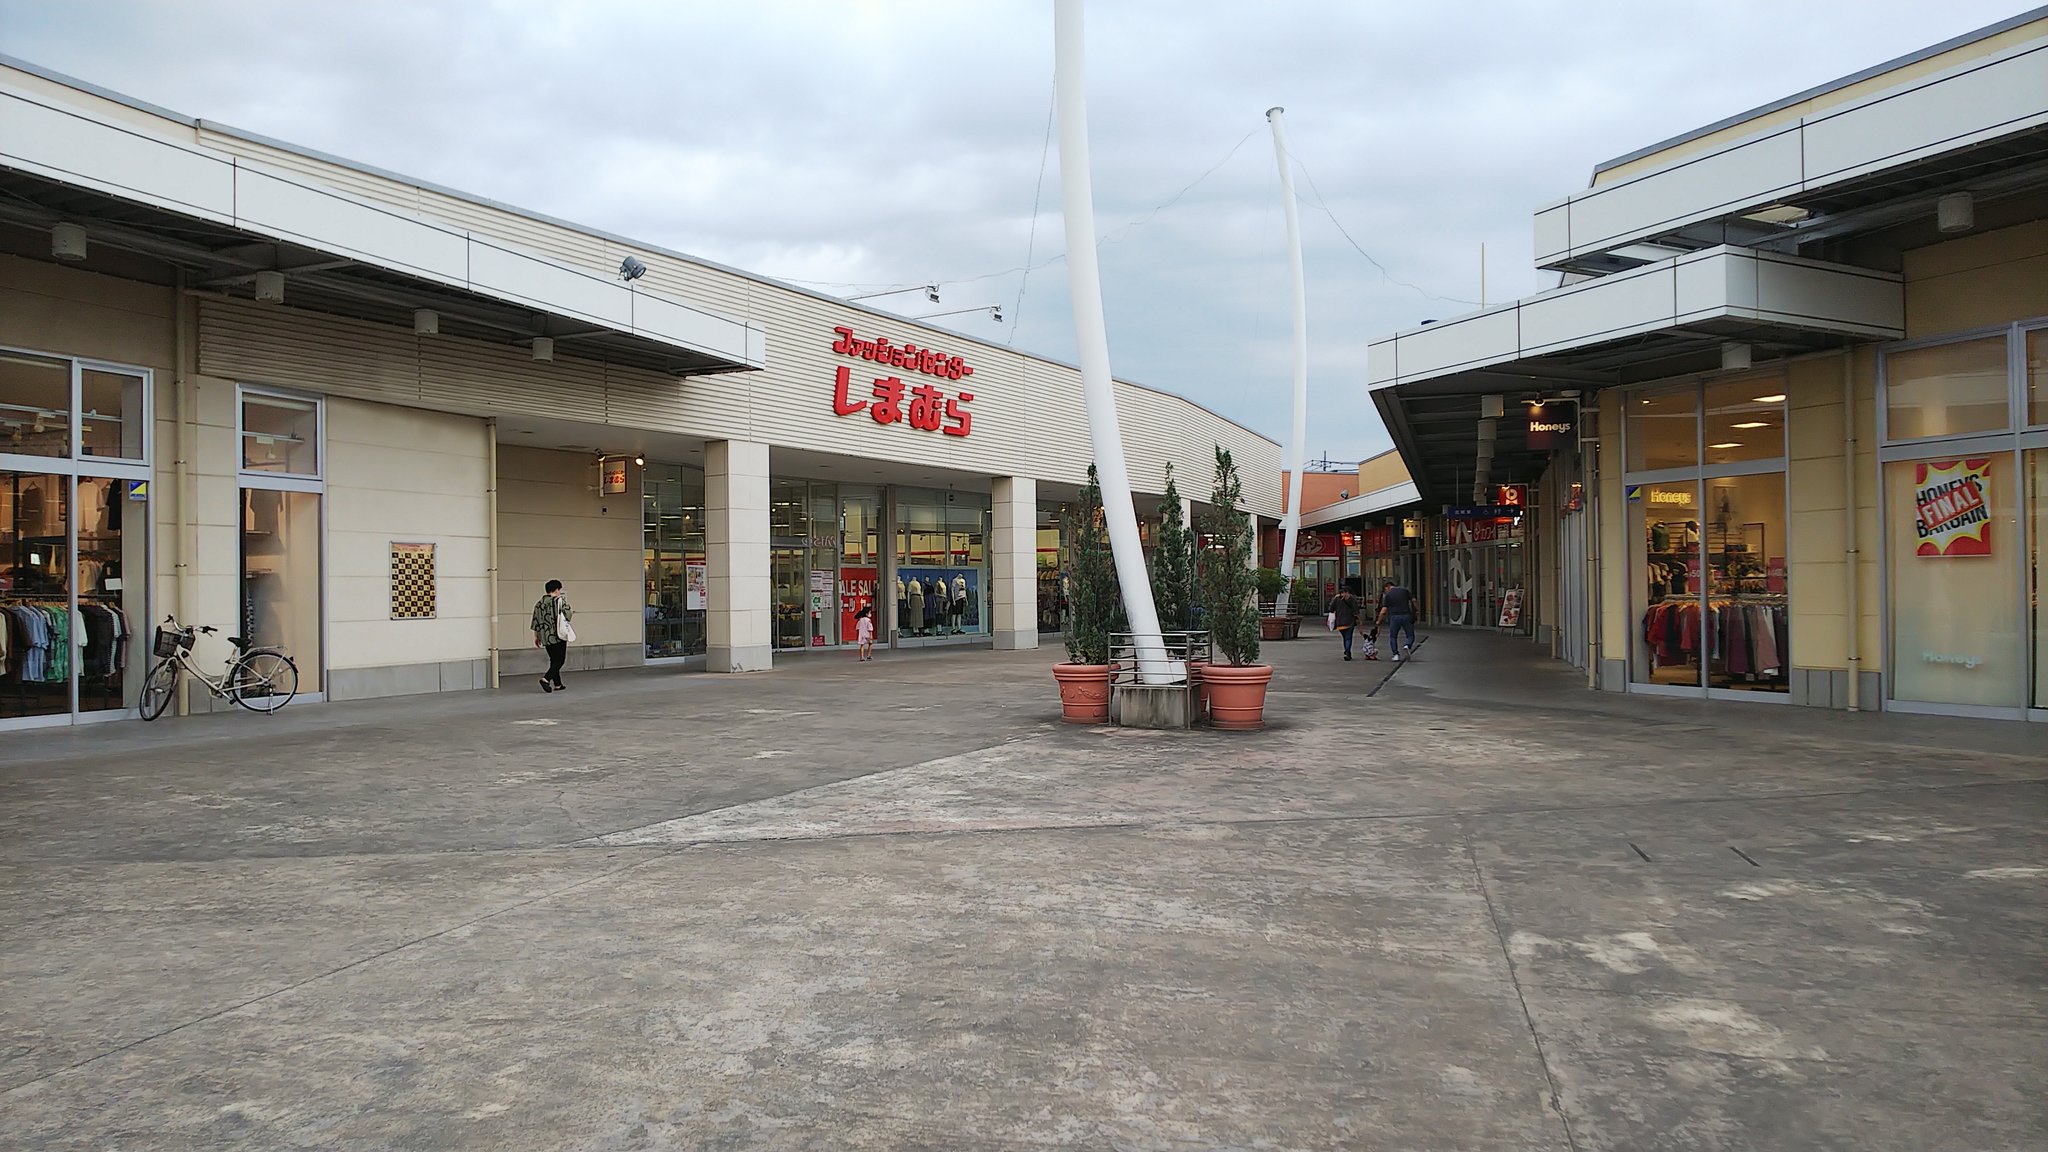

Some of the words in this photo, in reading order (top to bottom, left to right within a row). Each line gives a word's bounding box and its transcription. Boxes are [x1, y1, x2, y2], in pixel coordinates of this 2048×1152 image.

[832, 326, 974, 380] ファッションセンター
[833, 366, 975, 437] しまむら
[1530, 421, 1571, 433] Honeys
[1650, 488, 1692, 505] Honeys
[1922, 486, 1980, 525] FINAL
[839, 579, 857, 597] ALE
